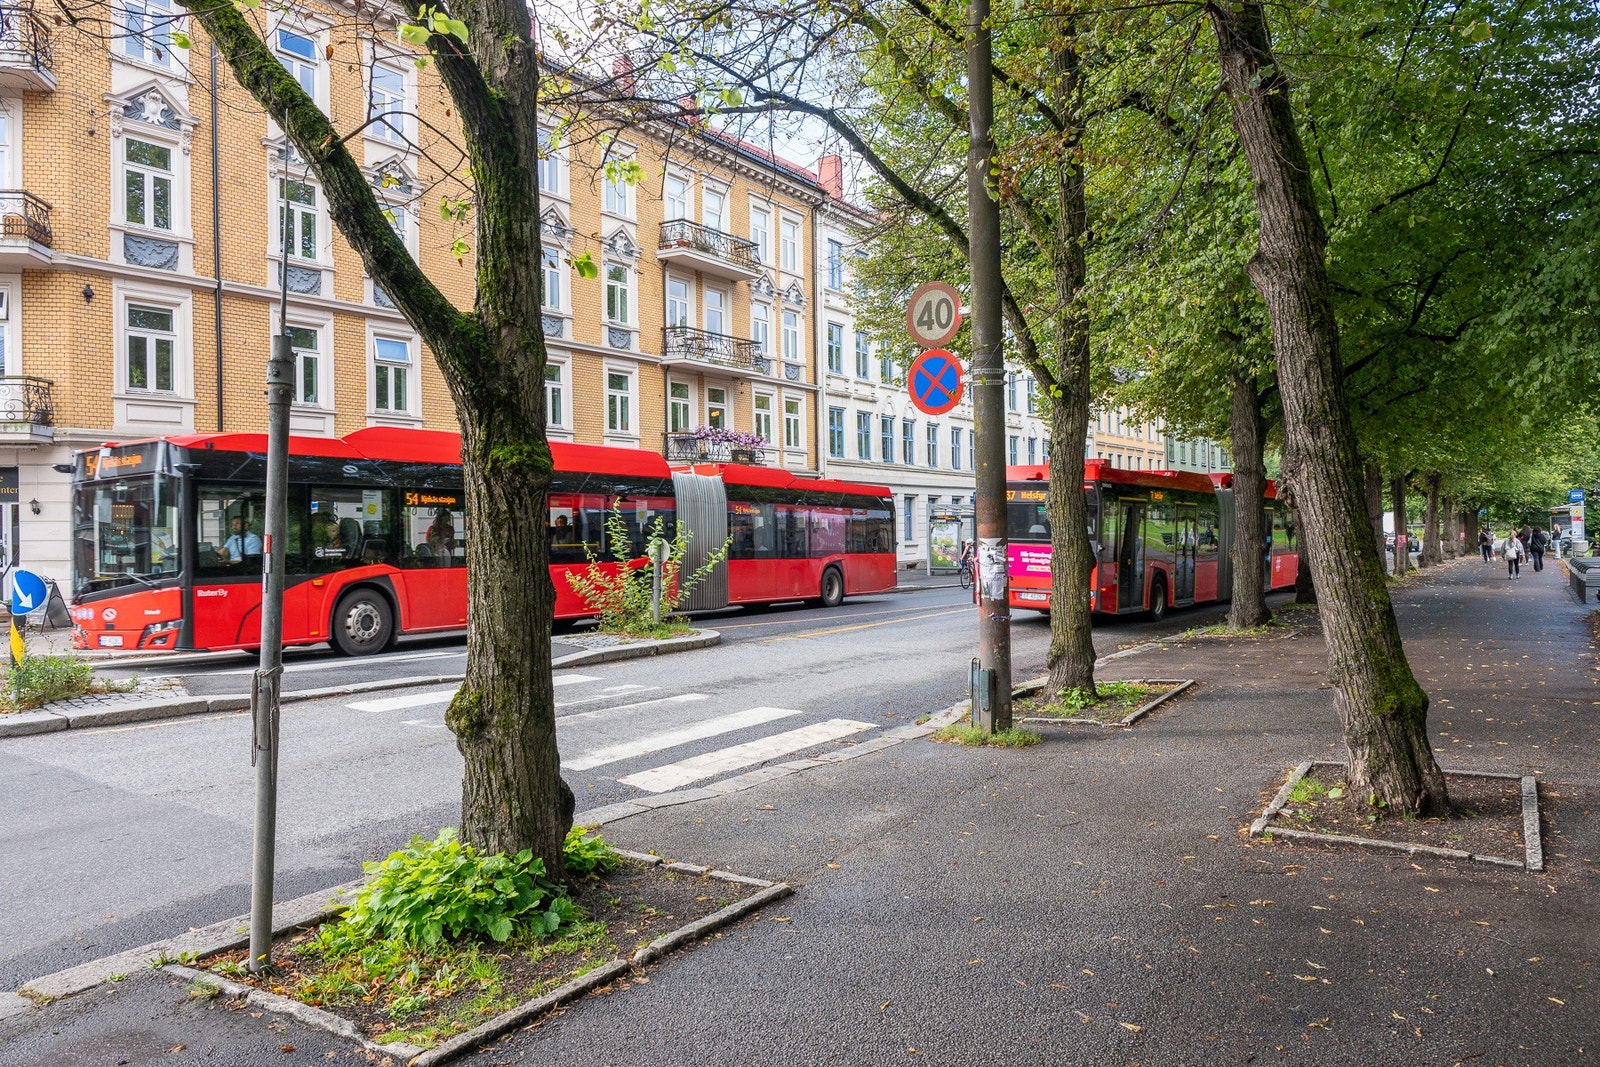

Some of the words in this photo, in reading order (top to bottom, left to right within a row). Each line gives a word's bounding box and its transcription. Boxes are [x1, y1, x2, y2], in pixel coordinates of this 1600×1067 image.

[917, 298, 953, 331] 40
[86, 455, 99, 476] 54
[406, 492, 419, 505] 54
